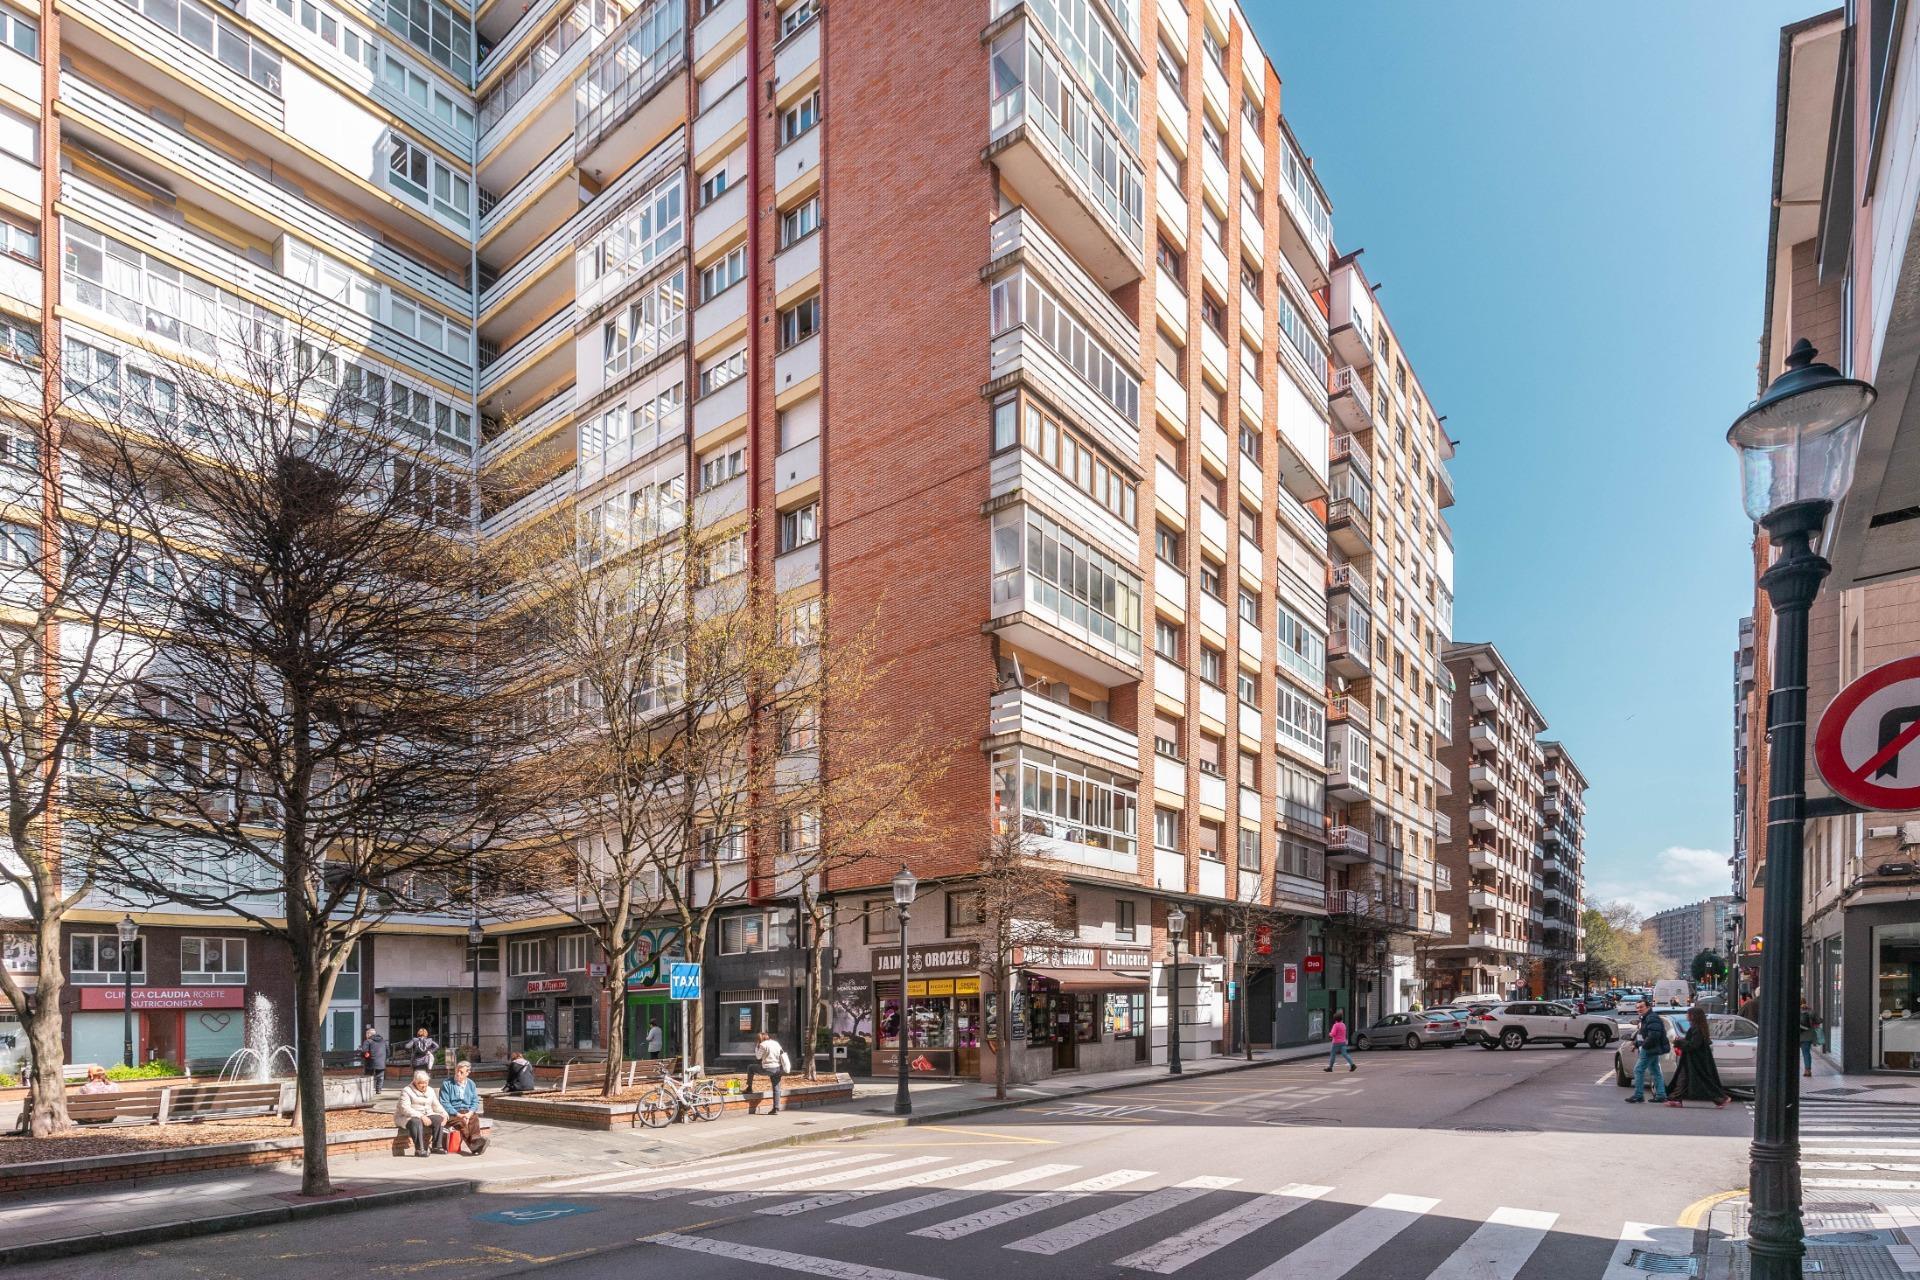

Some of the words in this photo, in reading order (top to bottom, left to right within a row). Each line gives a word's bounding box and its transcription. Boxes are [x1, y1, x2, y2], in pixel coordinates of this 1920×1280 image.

[925, 950, 970, 967] OROZKO
[1062, 948, 1094, 965] OROZKO
[672, 975, 699, 987] TAXI
[528, 982, 540, 992] BAR
[104, 991, 145, 999] CLINCA
[147, 990, 191, 999] CLAUDIA
[192, 990, 225, 998] ROSETE
[130, 1000, 204, 1008] NUTRICIONISTAS
